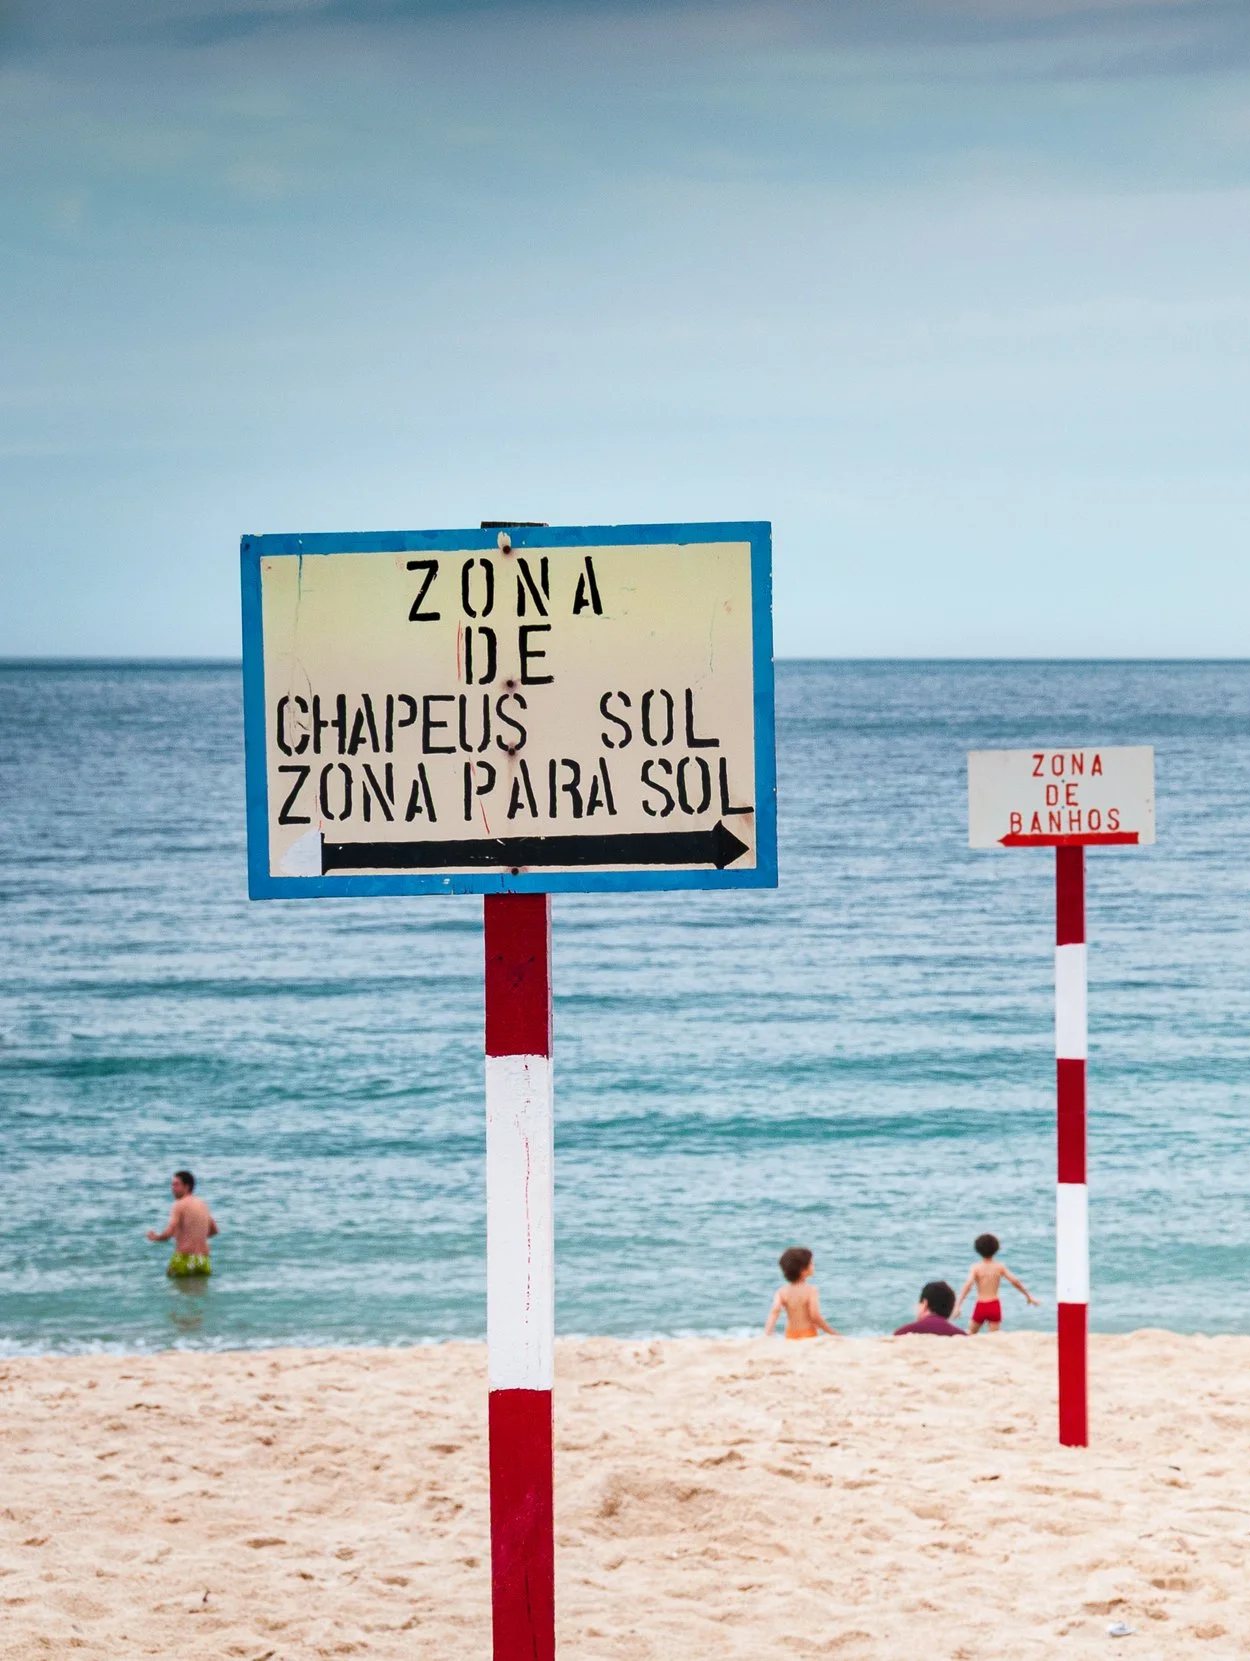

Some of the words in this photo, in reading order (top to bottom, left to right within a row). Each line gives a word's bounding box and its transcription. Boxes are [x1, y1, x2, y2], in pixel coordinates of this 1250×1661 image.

[406, 555, 603, 622] ZONA
[464, 623, 555, 685] DE
[276, 692, 528, 756] CHAPEUS
[600, 687, 719, 749] SOL
[277, 761, 437, 825] ZONA
[463, 756, 618, 822] PARA
[641, 756, 755, 817] SOL
[1032, 753, 1103, 777] ZONA
[1046, 783, 1079, 806] DE
[1010, 808, 1120, 834] BANHOS
